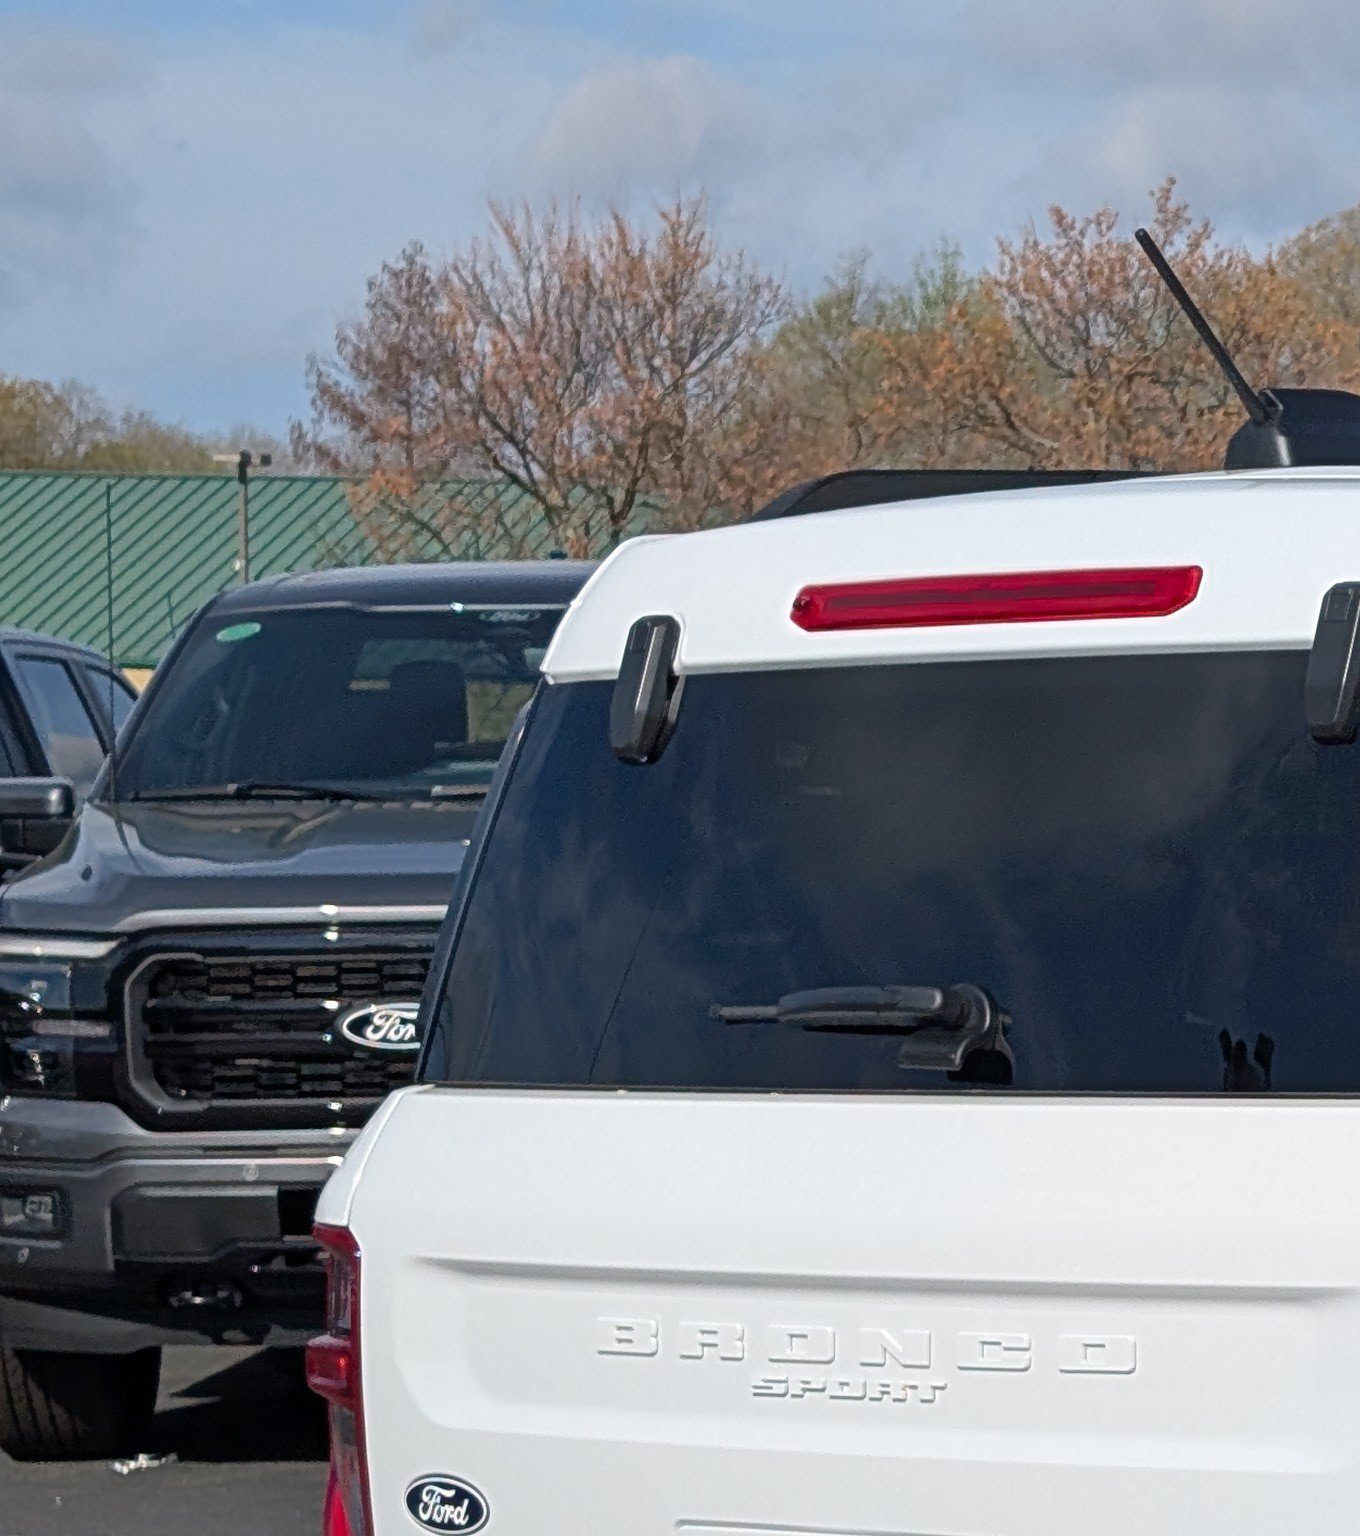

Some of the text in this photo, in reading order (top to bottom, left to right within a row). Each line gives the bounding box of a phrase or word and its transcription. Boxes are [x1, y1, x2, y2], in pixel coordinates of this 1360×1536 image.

[366, 1010, 418, 1041] For
[596, 1315, 1138, 1375] BRONCO
[751, 1375, 948, 1403] SPORT
[418, 1484, 469, 1526] Ford
